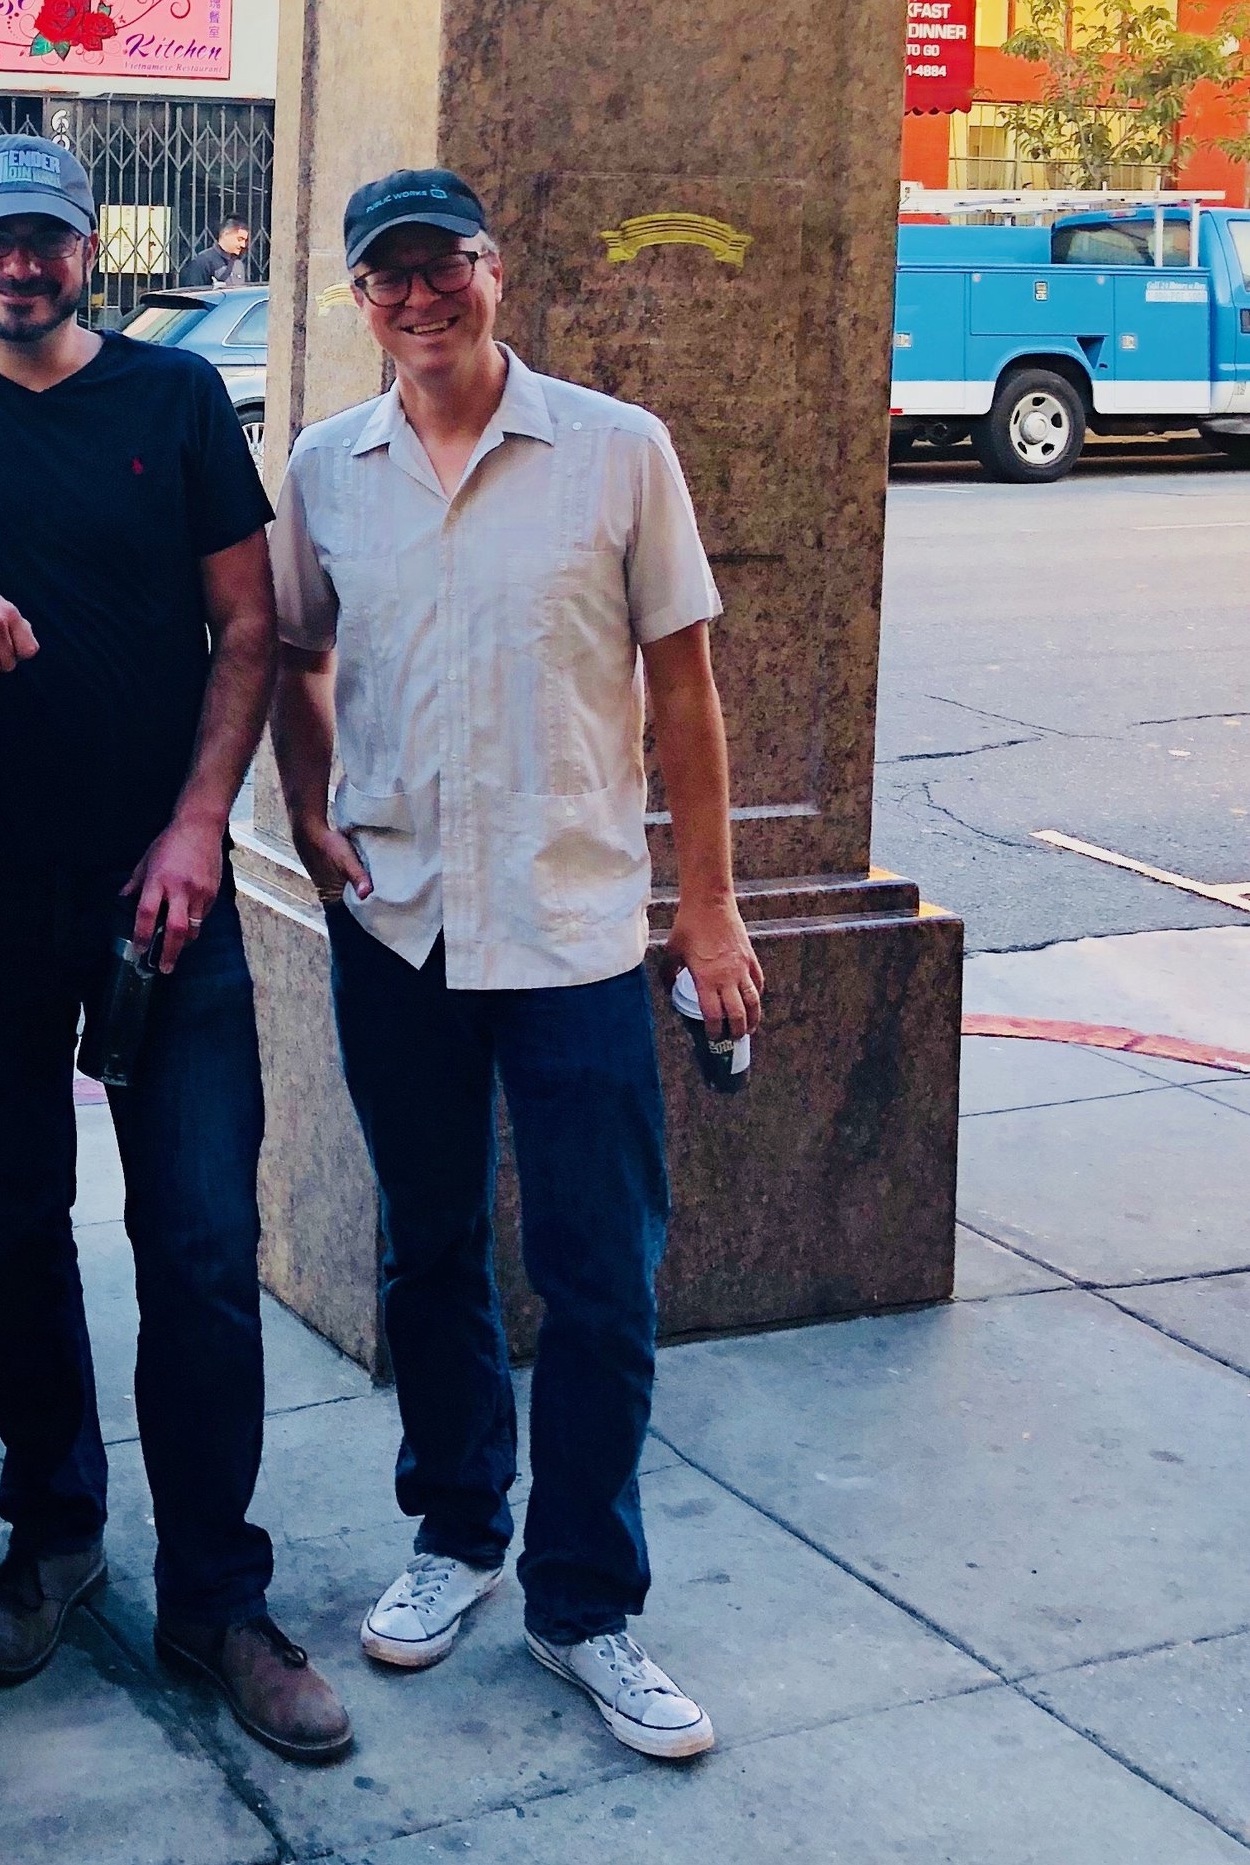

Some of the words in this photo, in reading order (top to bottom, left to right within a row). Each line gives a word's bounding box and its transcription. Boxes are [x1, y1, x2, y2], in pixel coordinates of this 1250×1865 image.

[908, 23, 967, 39] DINNER
[125, 33, 222, 61] Kitchen
[906, 44, 920, 56] TO
[923, 44, 940, 57] GO
[176, 63, 223, 74] Restaurant
